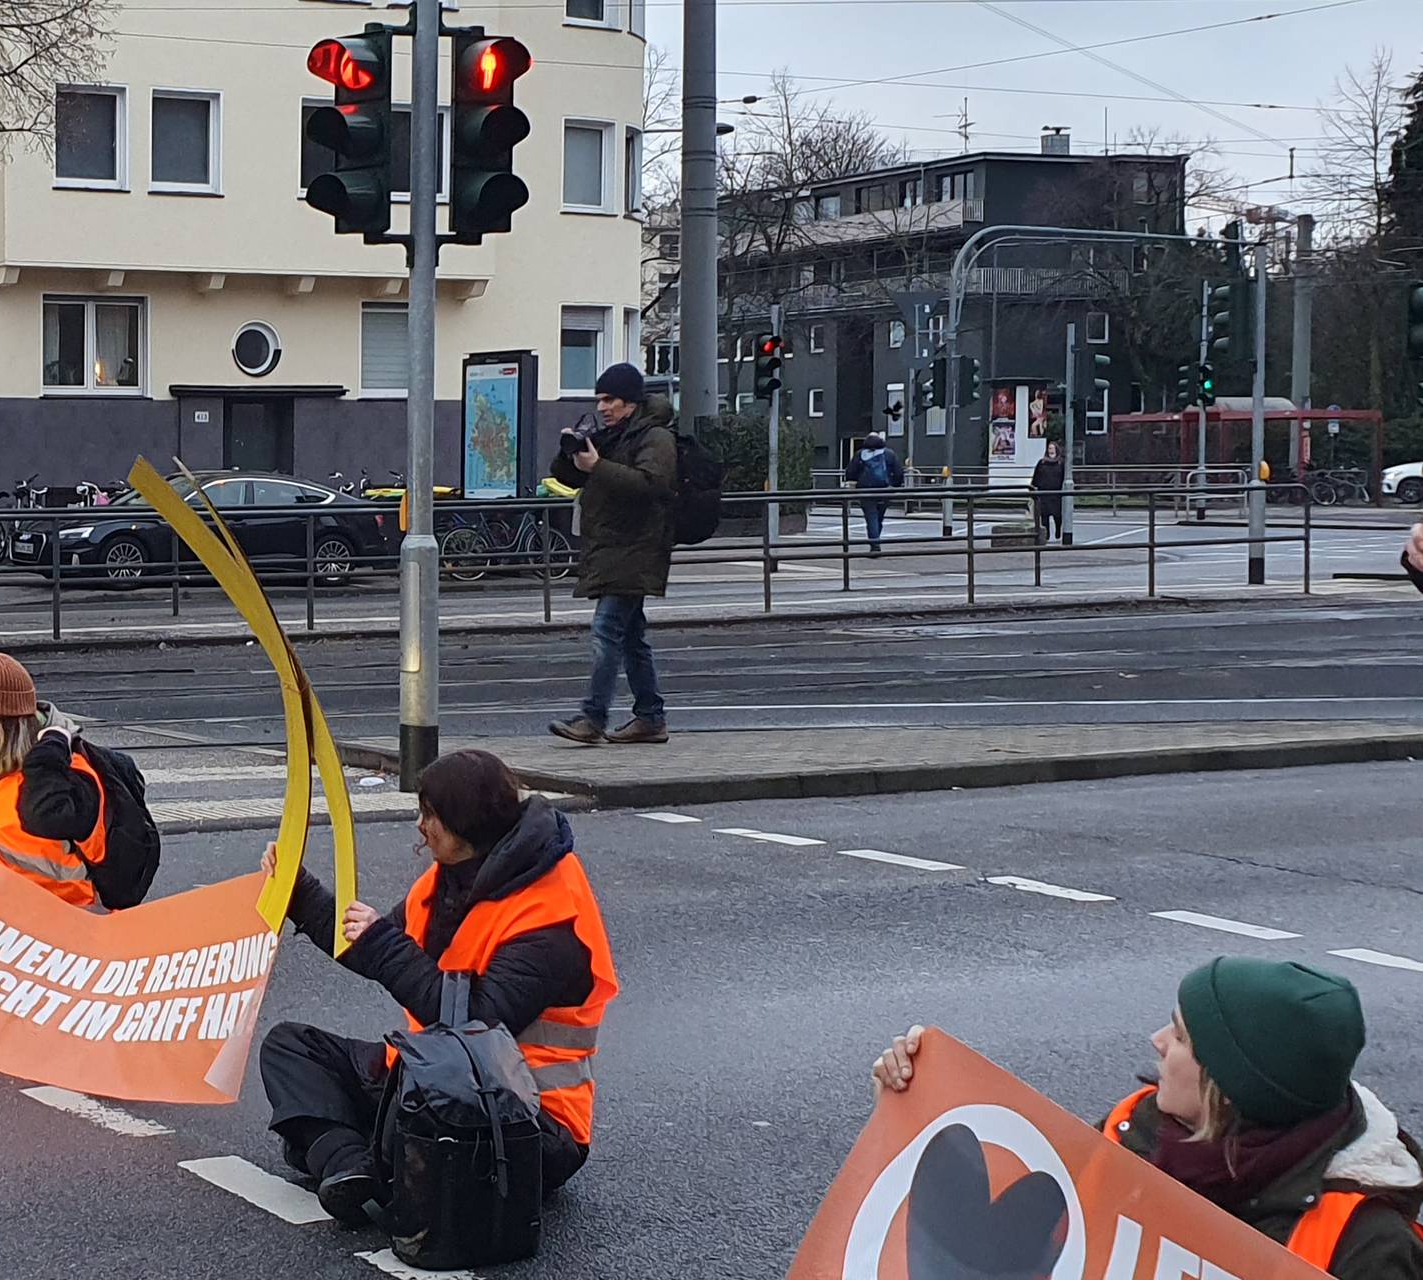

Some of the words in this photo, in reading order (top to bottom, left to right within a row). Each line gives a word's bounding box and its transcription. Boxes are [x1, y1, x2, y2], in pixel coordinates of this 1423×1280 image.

[92, 957, 150, 997] DIE
[142, 930, 278, 994] REGIERUNG
[58, 1000, 122, 1041] IM
[112, 996, 203, 1042] GRIFF
